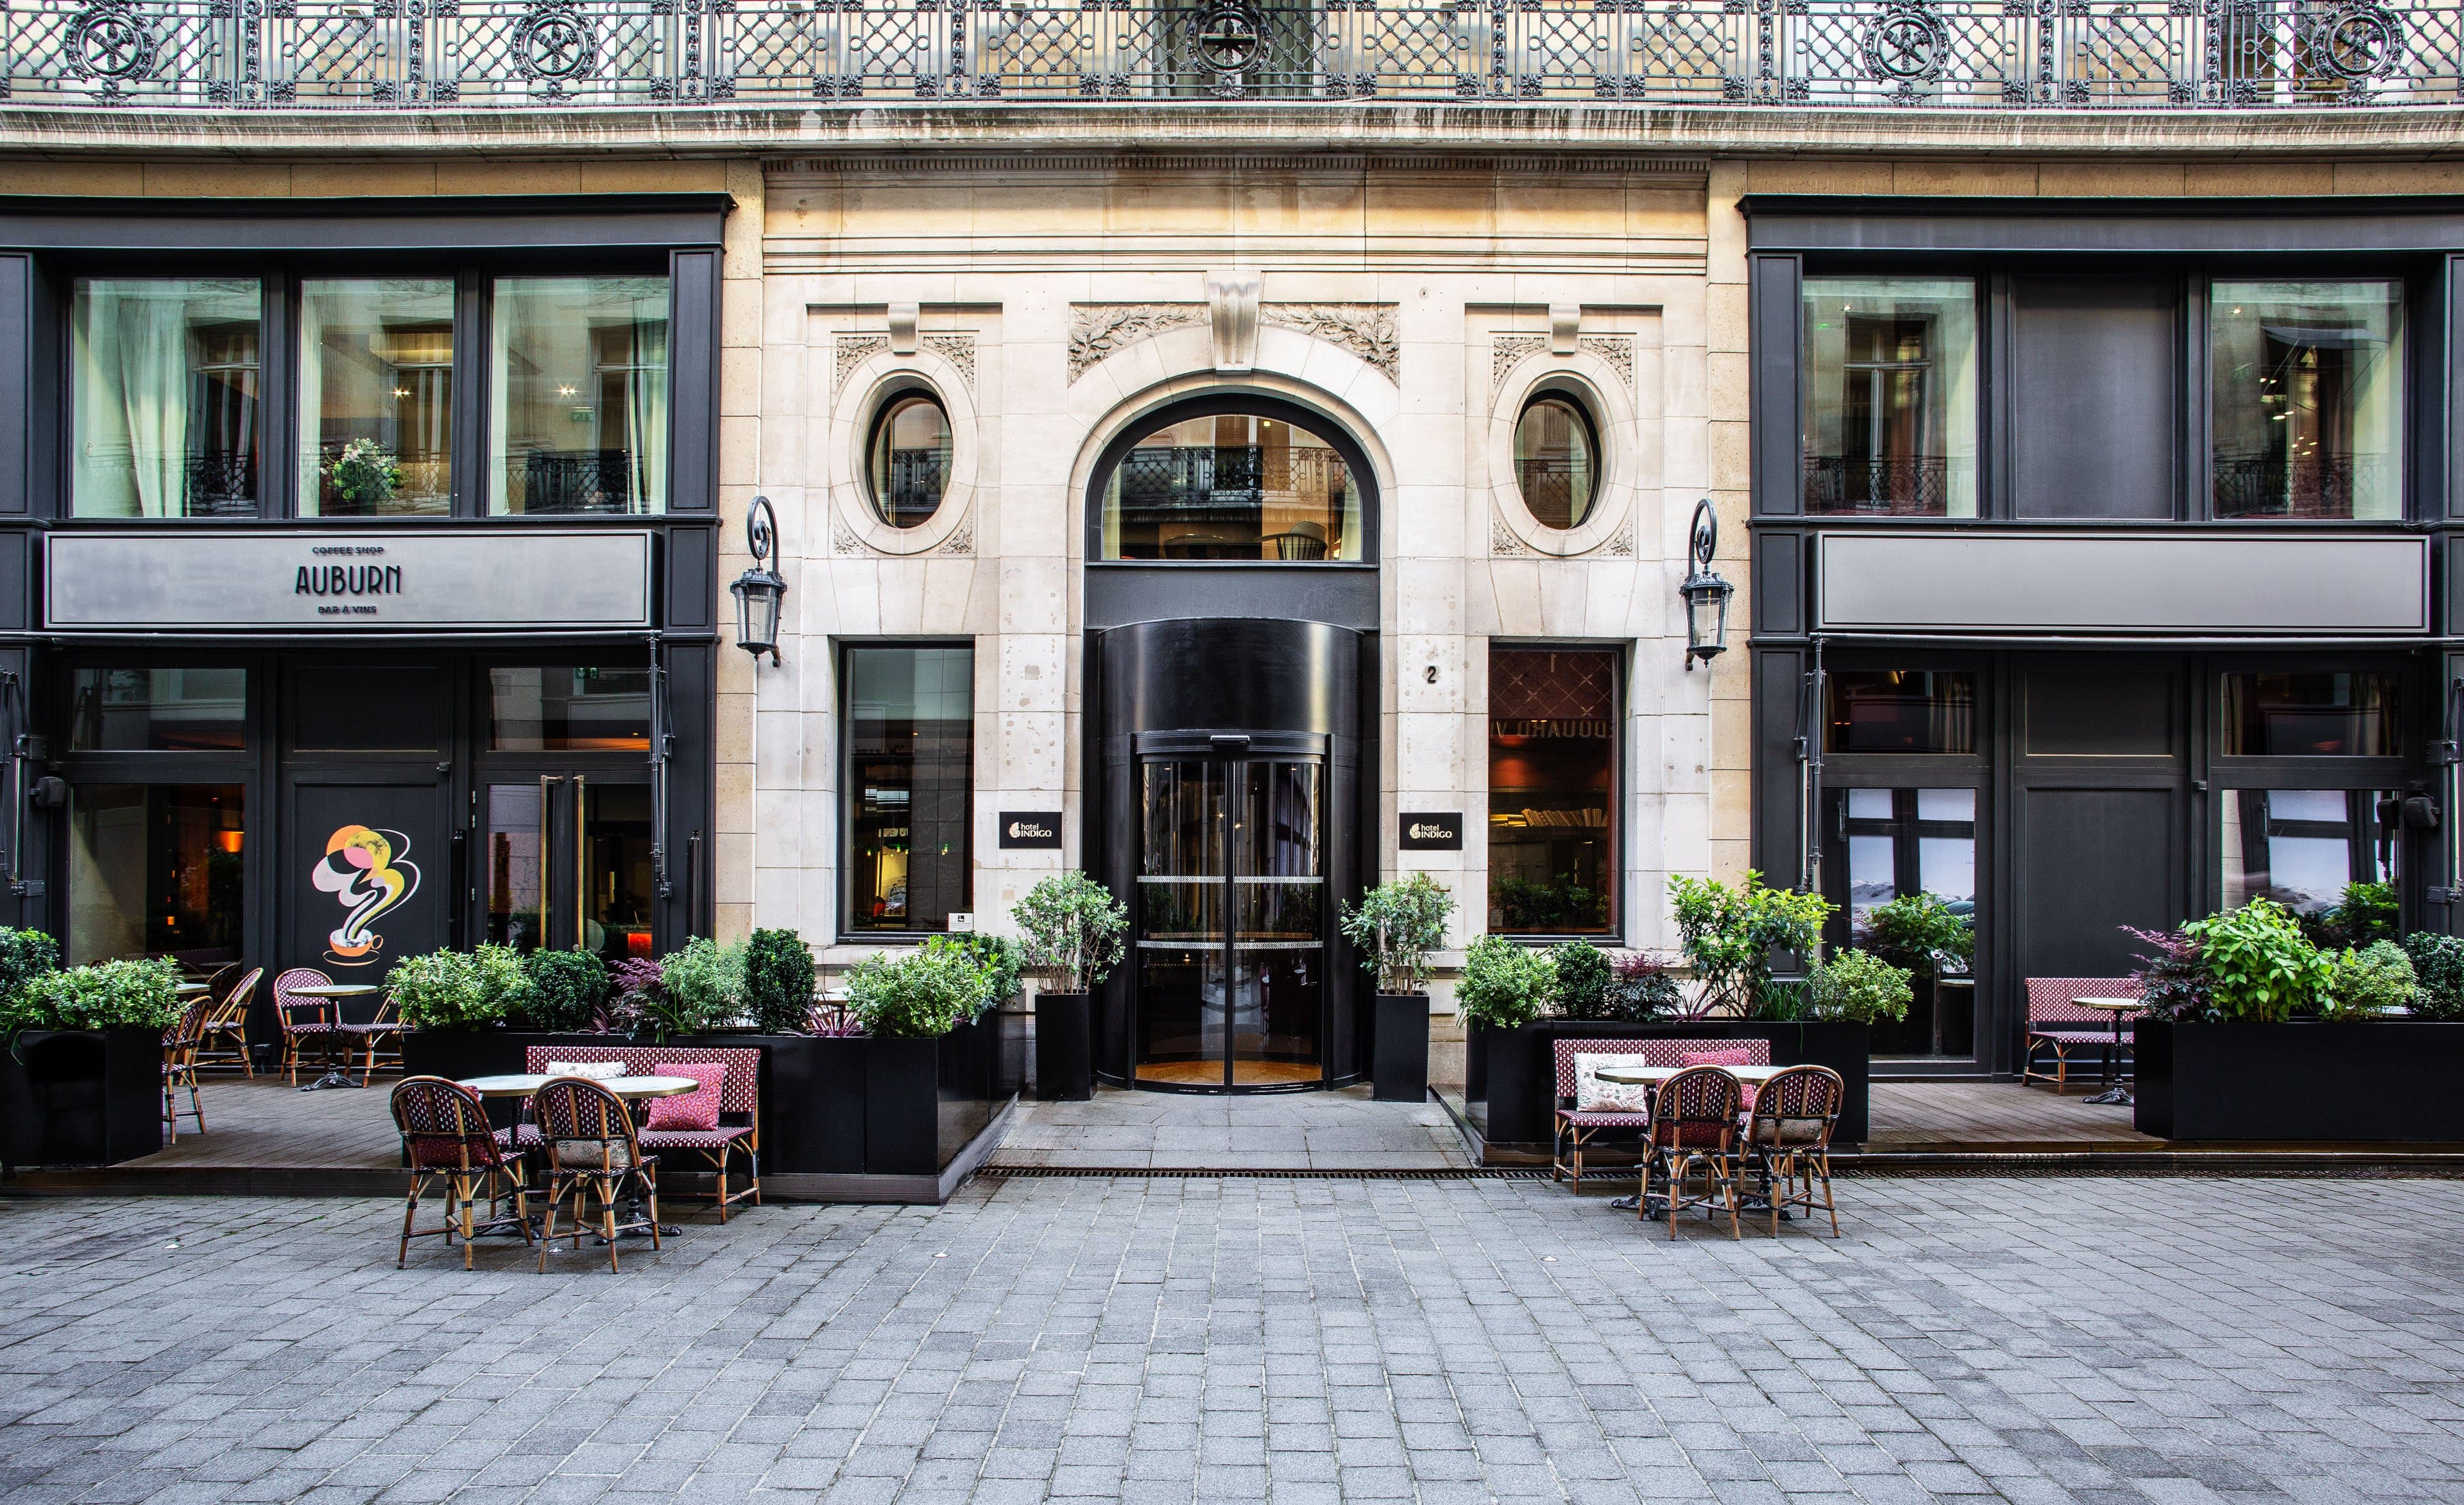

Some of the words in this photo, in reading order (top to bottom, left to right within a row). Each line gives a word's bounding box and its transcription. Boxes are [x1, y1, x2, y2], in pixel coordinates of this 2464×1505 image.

[312, 546, 354, 556] COFFEE
[355, 546, 385, 556] SHOP
[295, 565, 401, 594] AUBURN
[318, 605, 340, 614] BAR
[352, 605, 377, 614] VINS
[1427, 666, 1437, 684] 2
